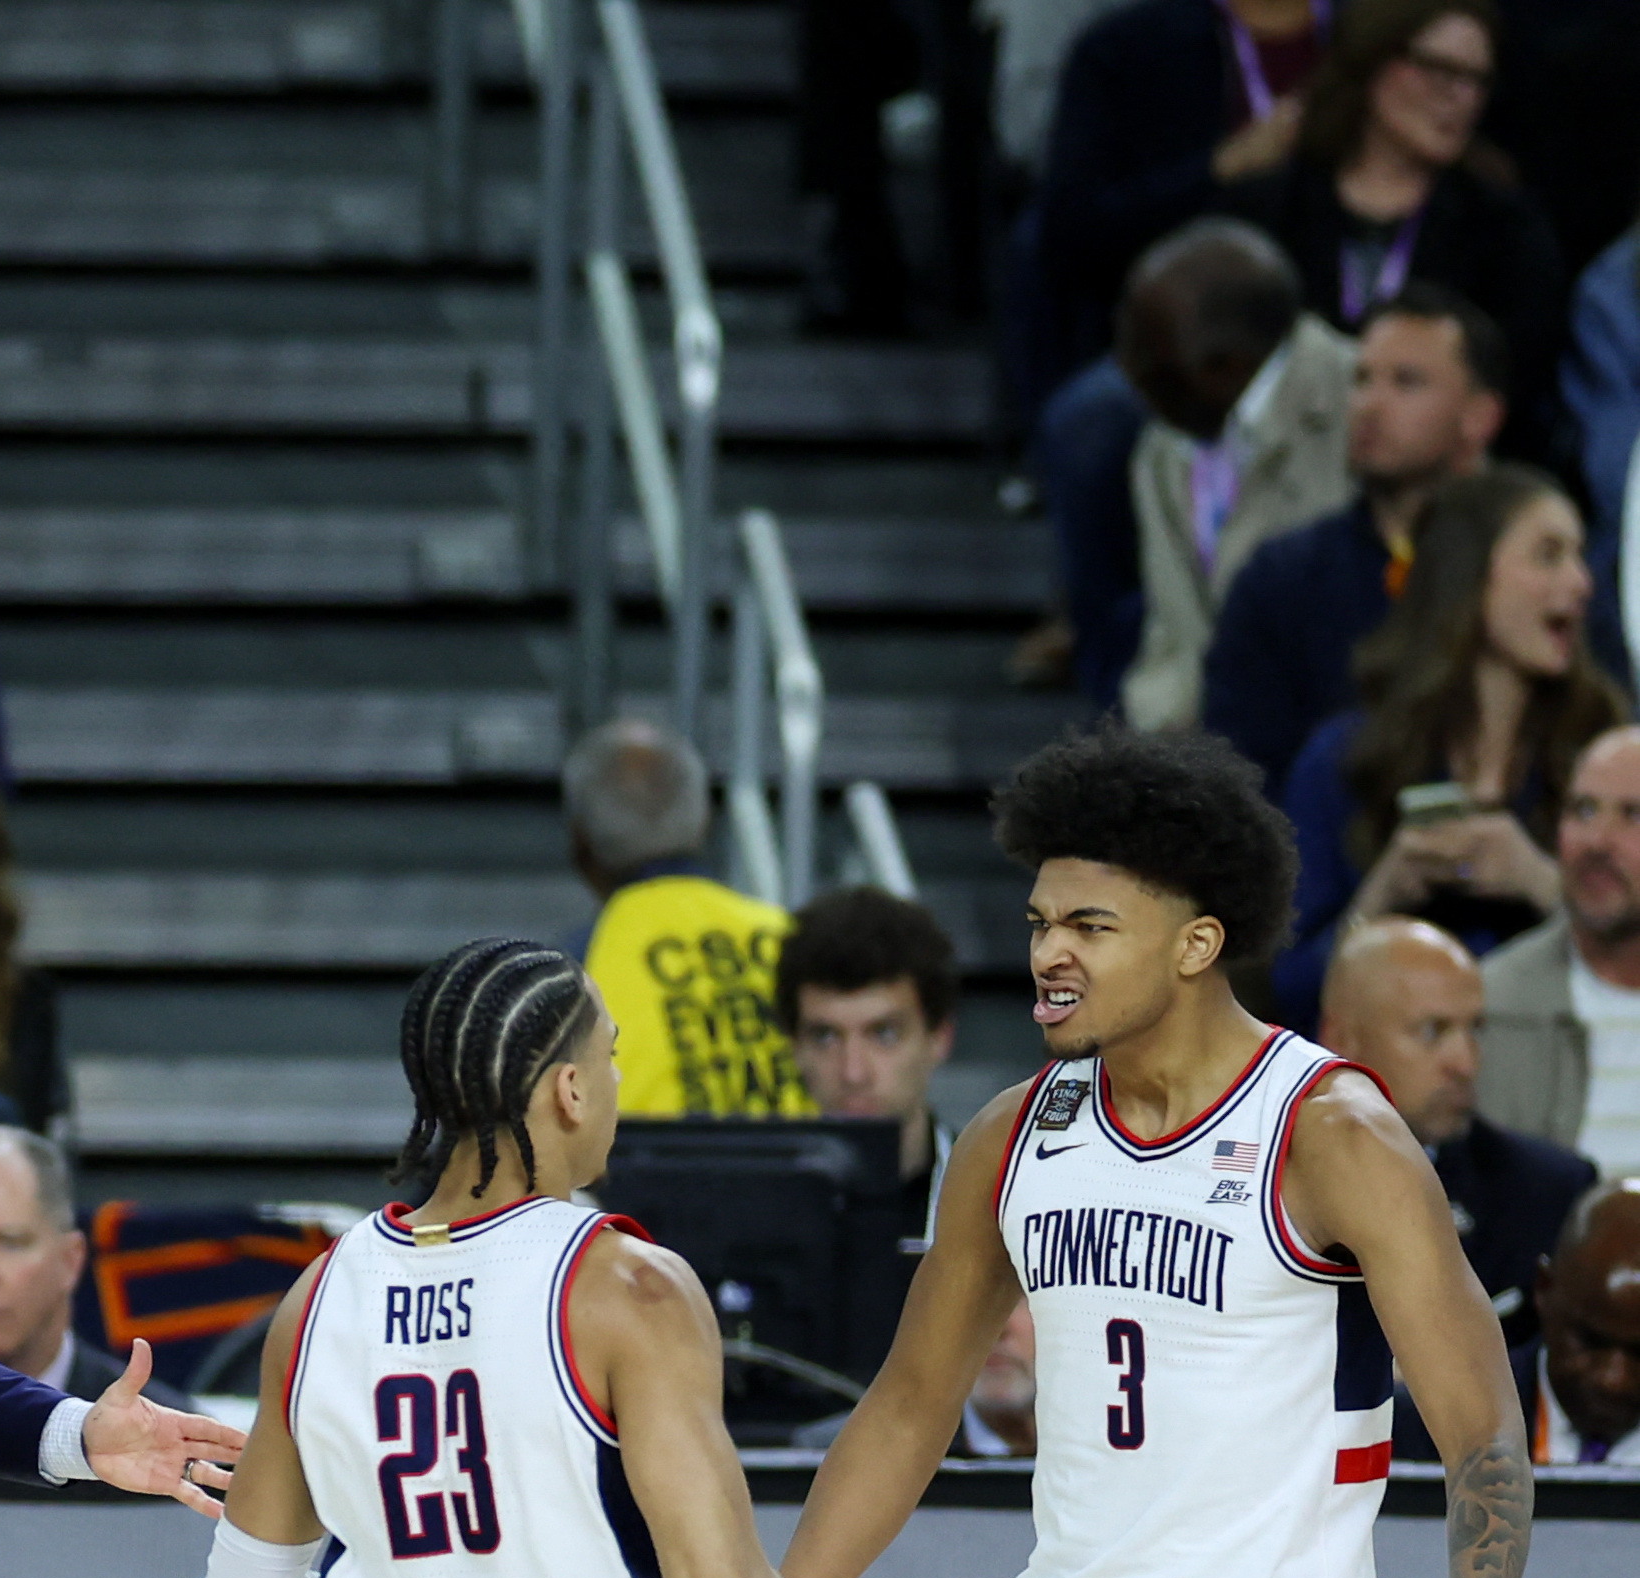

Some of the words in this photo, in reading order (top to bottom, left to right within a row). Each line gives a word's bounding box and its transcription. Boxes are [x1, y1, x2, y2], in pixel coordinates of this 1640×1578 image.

[1052, 1088, 1082, 1100] FINAL
[1042, 1110, 1071, 1122] FOUR
[1209, 1190, 1253, 1202] EAST
[1217, 1179, 1248, 1191] BIG
[1023, 1207, 1234, 1313] CONNECTICUT
[384, 1277, 474, 1345] ROSS
[1105, 1317, 1146, 1451] 3
[374, 1367, 502, 1560] 23
